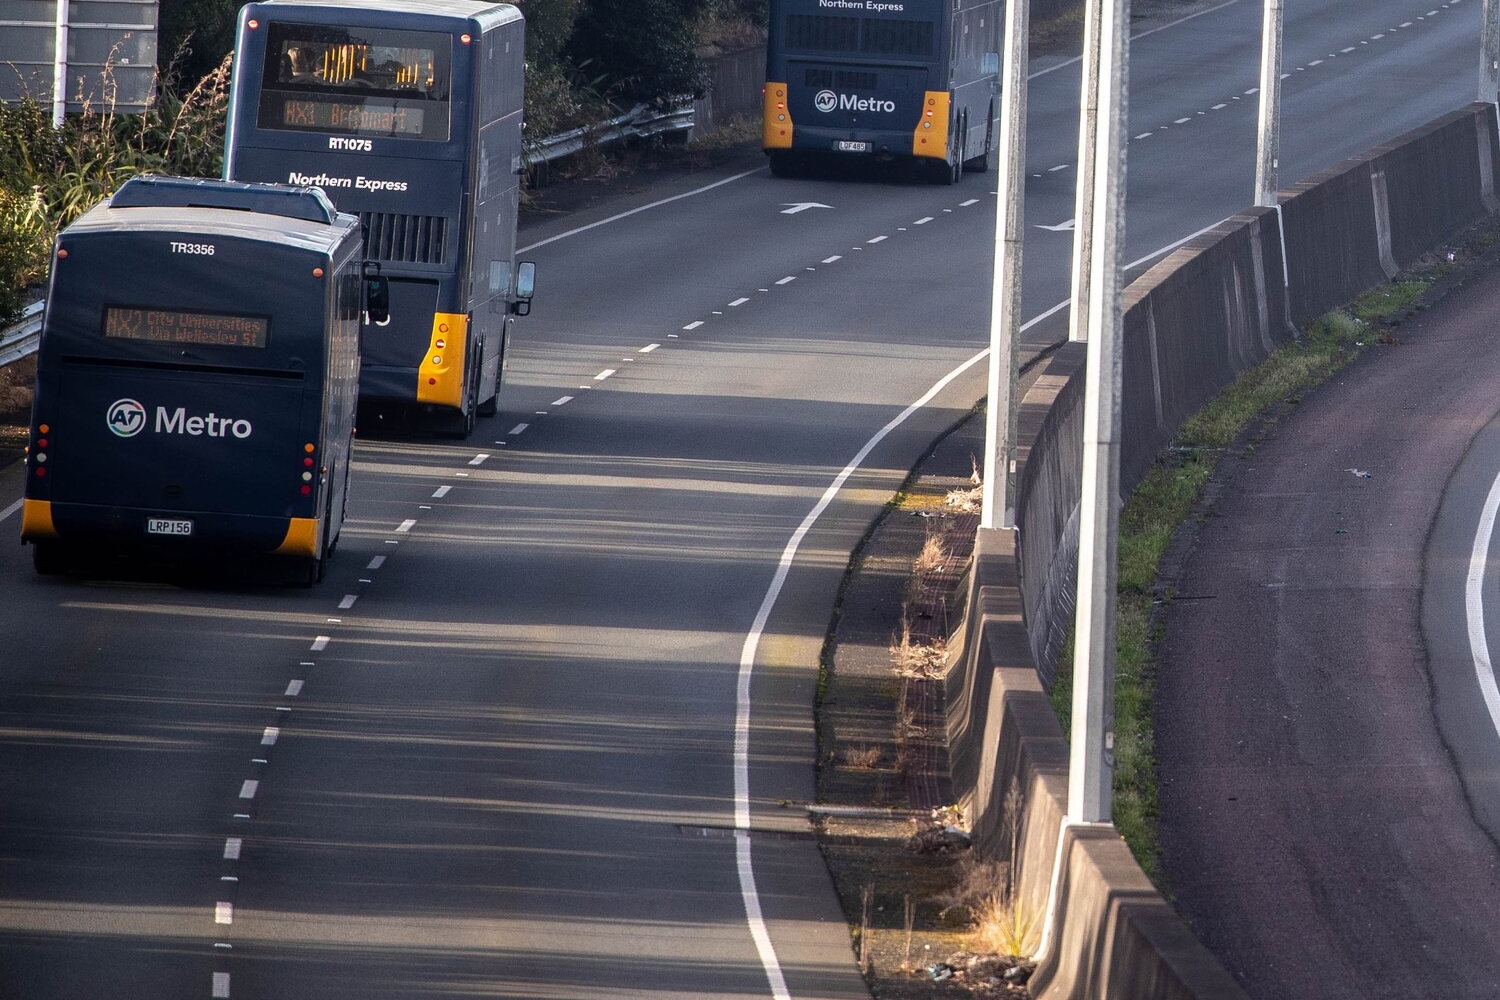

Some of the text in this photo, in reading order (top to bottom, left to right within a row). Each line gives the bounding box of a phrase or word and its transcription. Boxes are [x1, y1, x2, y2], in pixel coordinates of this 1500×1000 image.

[866, 0, 904, 12] Express
[840, 93, 896, 113] Metro
[284, 100, 315, 125] NX1
[329, 137, 373, 152] RT1075
[288, 172, 408, 192] Northern Express
[169, 241, 215, 256] TR3356
[105, 307, 261, 338] NX2 City Universities
[175, 328, 238, 345] Wellesley
[154, 406, 252, 439] Metro
[149, 520, 190, 534] LRP156
